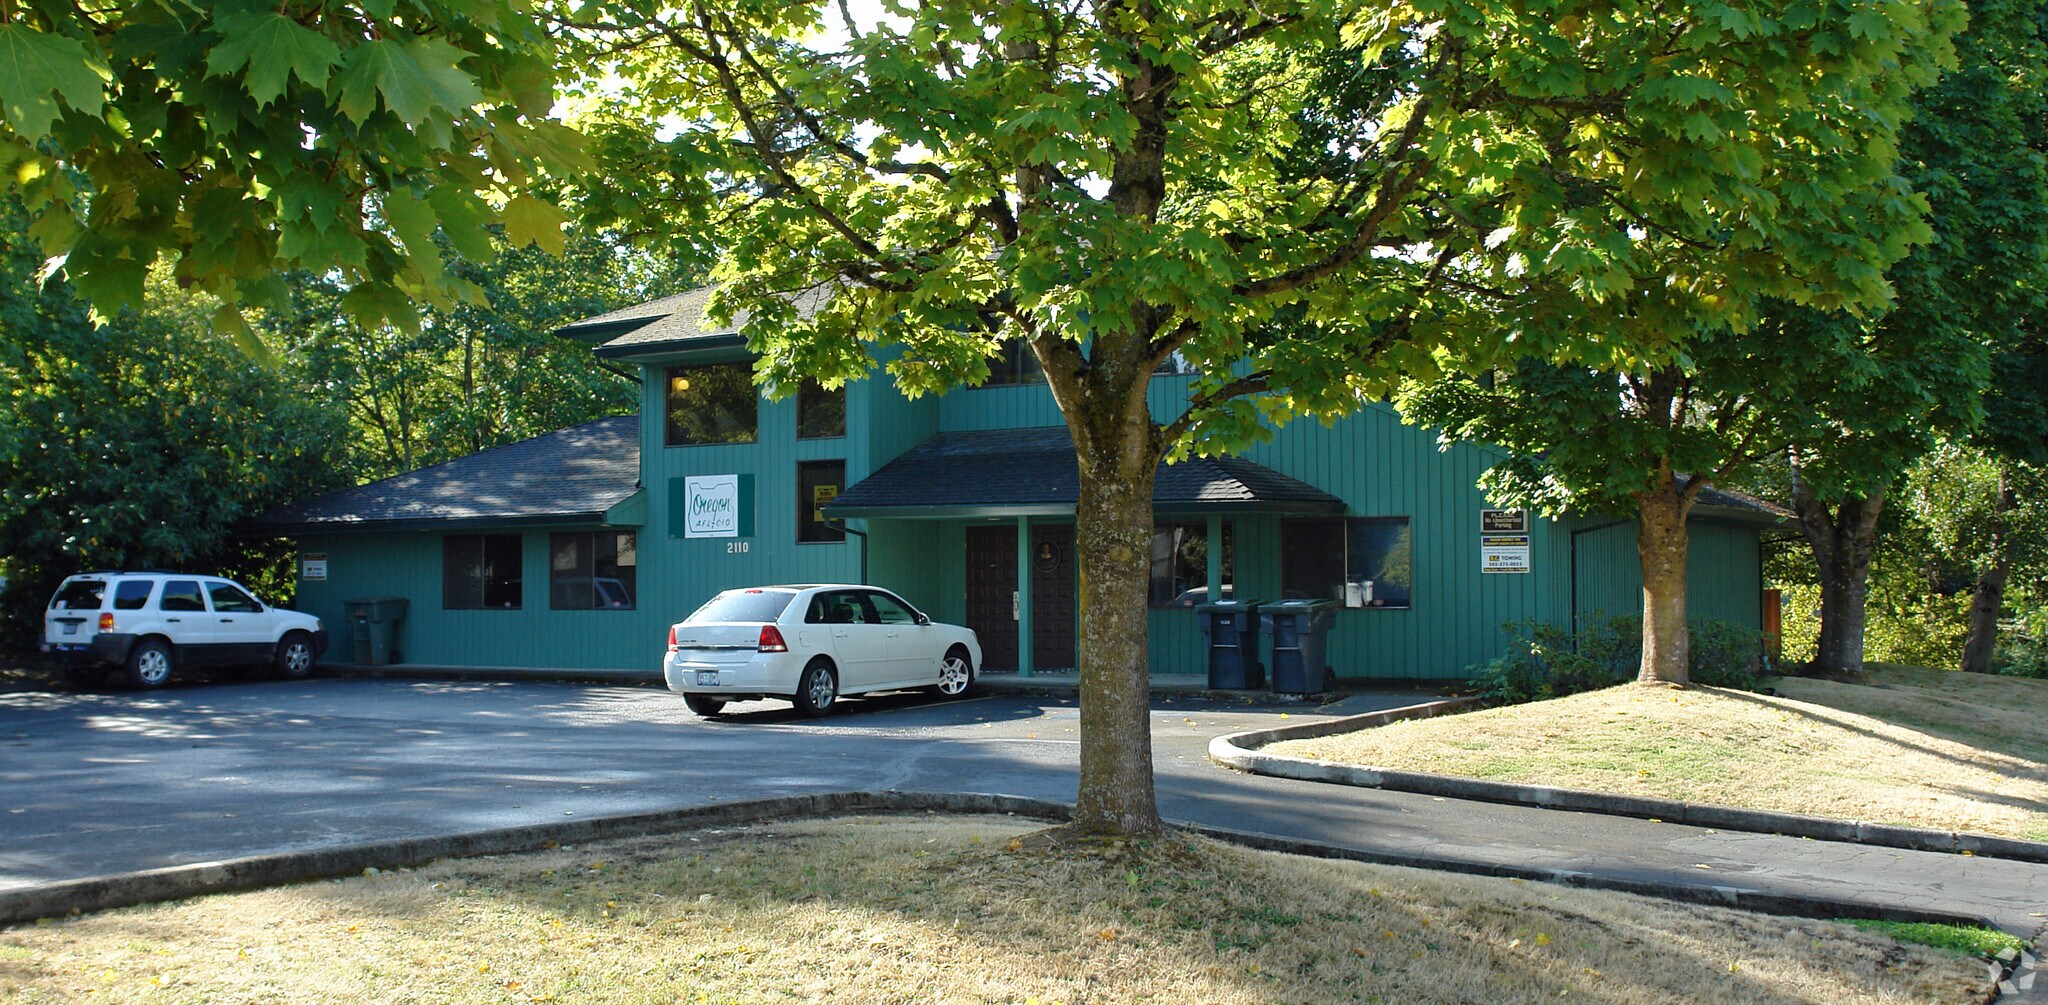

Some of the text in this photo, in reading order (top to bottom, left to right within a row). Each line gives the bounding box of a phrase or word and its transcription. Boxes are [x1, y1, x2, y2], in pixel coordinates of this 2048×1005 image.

[693, 493, 731, 522] Oregon
[695, 519, 731, 528] AFL-CIO
[727, 542, 749, 553] 2110
